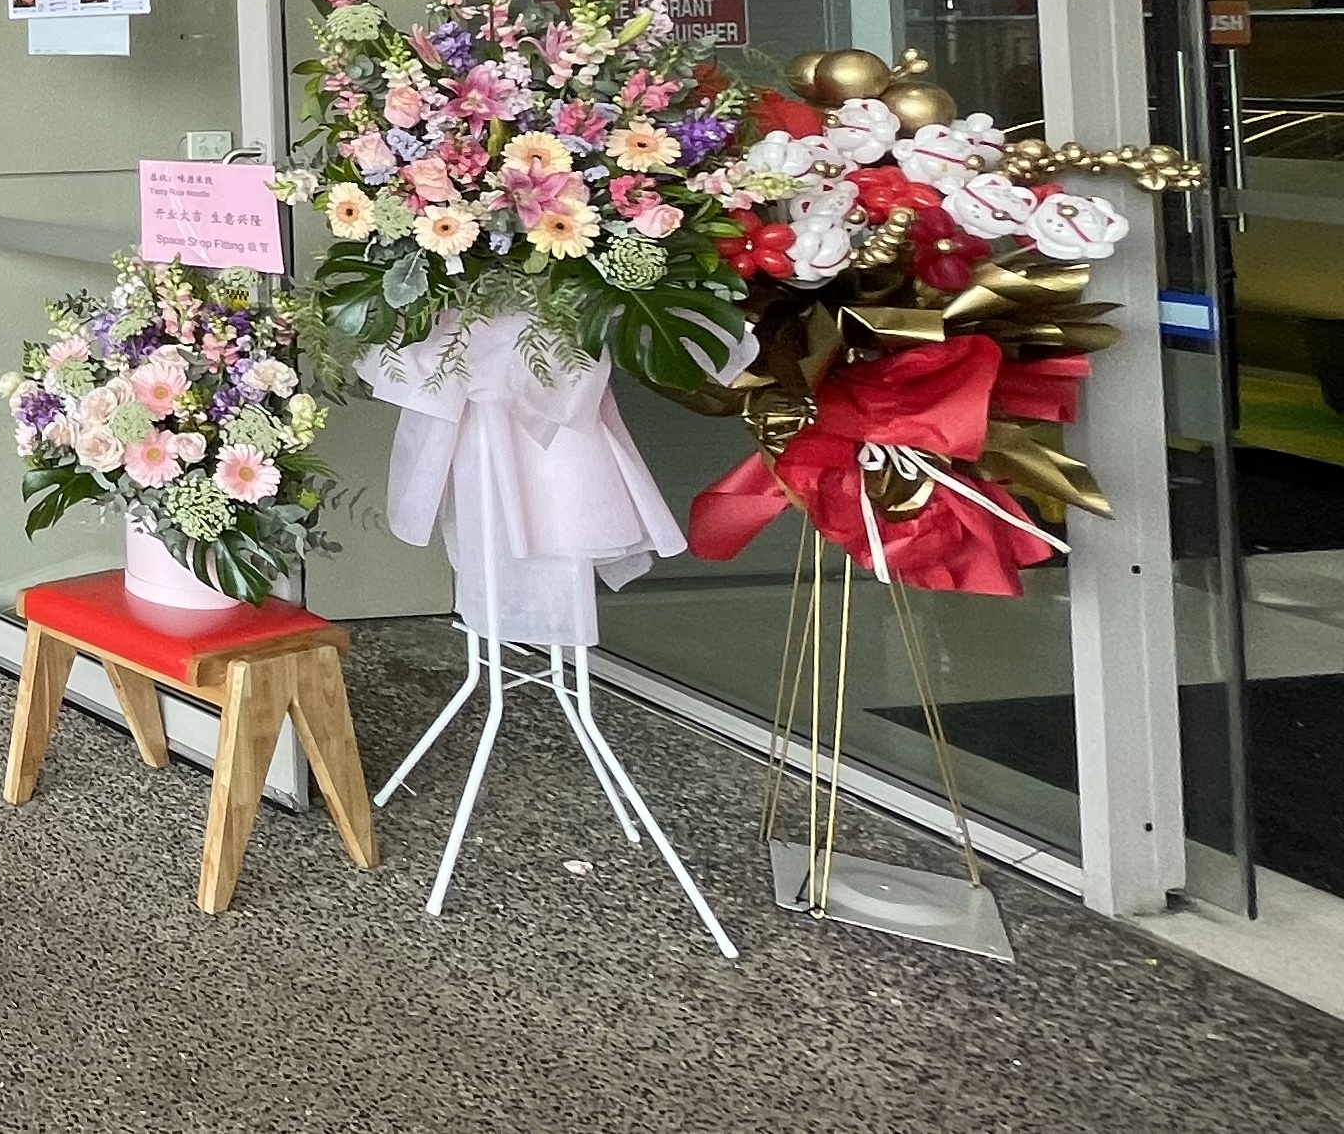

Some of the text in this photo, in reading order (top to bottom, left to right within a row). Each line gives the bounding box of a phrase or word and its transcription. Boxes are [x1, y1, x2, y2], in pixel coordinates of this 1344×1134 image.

[154, 208, 263, 227] 开业大吉 生意兴隆
[156, 234, 186, 247] Space
[214, 239, 245, 253] Fitting
